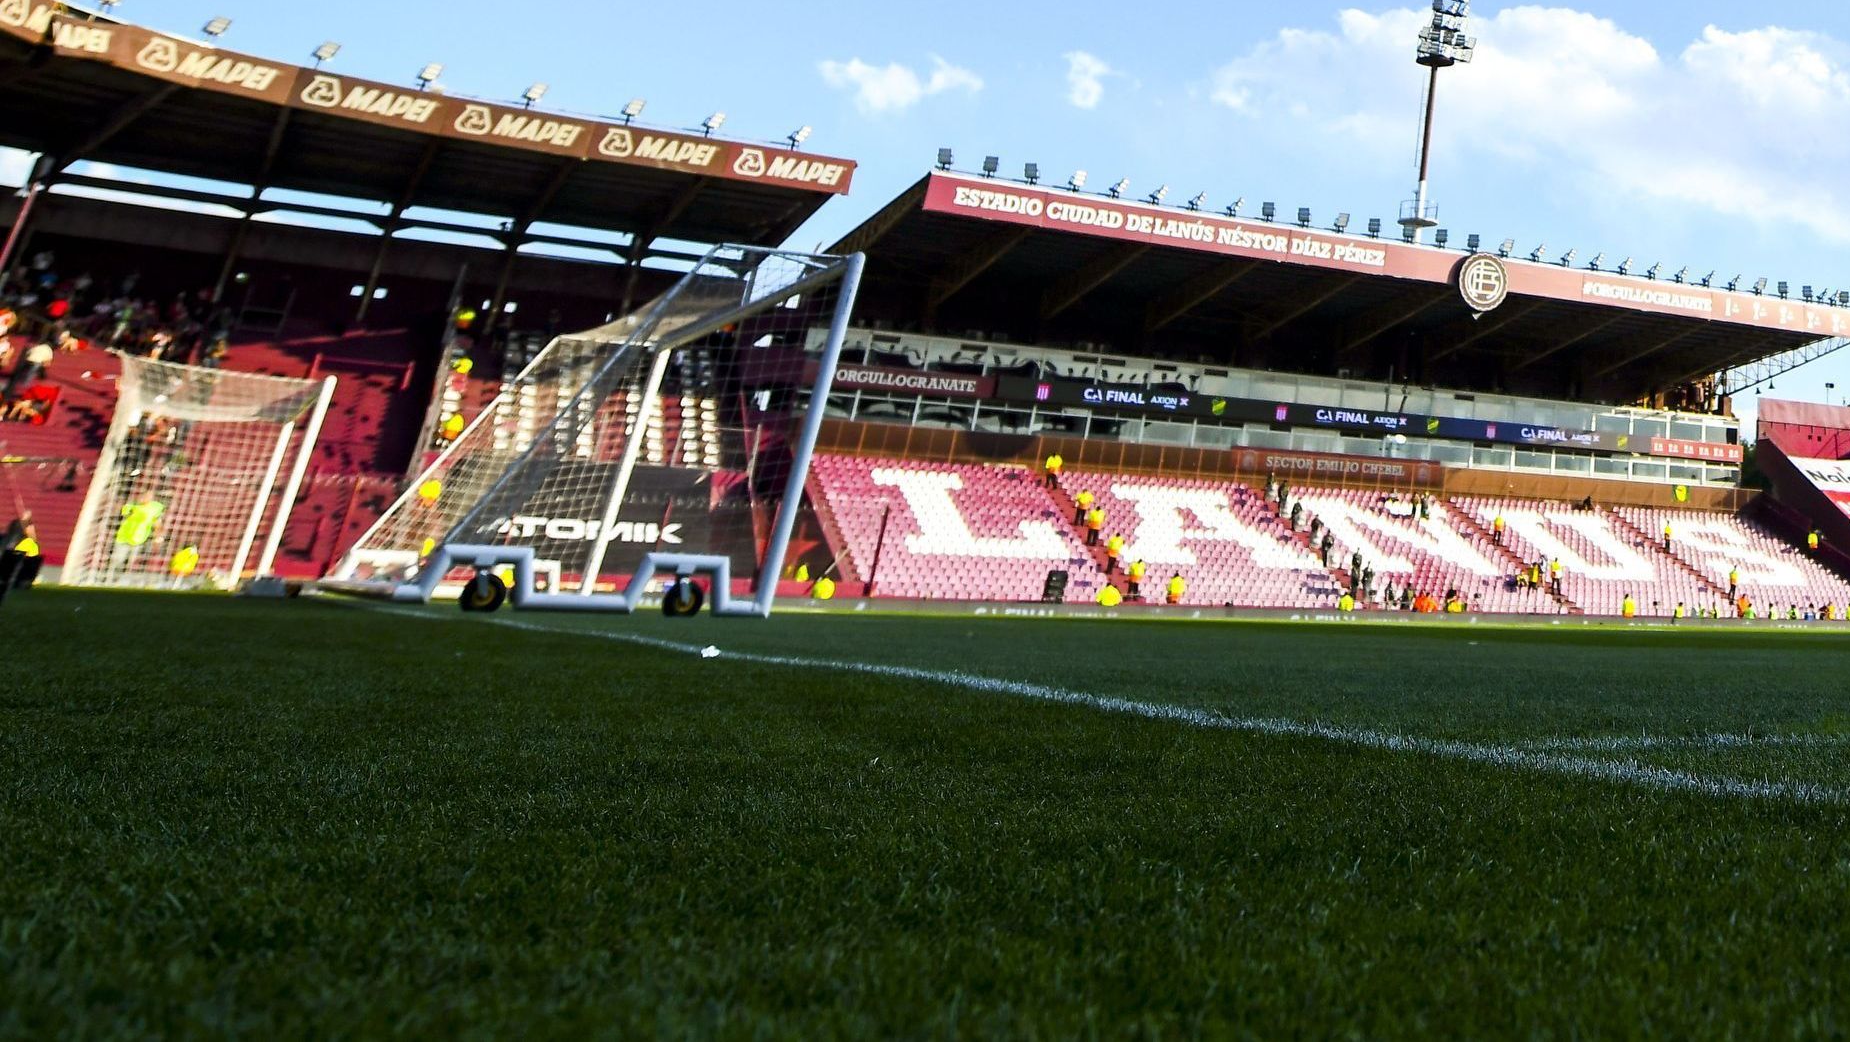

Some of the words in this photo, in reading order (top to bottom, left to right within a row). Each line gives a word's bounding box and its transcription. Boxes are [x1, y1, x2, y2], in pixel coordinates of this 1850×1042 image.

[52, 21, 112, 53] APEI
[176, 51, 280, 91] MAPEI
[341, 86, 439, 124] MAPEI
[492, 113, 584, 147] MAPEI
[634, 135, 718, 166] MAPEI
[766, 156, 844, 186] MAPEI
[953, 187, 1044, 216] ESTADIO
[1046, 201, 1124, 229] CIUDAD
[1124, 213, 1153, 233] DE
[1154, 218, 1216, 243] LANÚS
[1217, 224, 1289, 254] NÉSTOR
[1290, 237, 1332, 259] DÍAZ
[1332, 241, 1386, 267] PÉREZ
[1582, 280, 1713, 312] #ORGULLOGRANATE
[836, 367, 977, 394] ORGULLOGRANATE
[1106, 390, 1145, 405] FINAL
[1335, 410, 1370, 424] FINAL
[1537, 428, 1568, 442] FINAL
[1265, 455, 1315, 471] SECTOR
[1316, 458, 1359, 473] EMILIO
[1361, 460, 1405, 476] CHEBEL
